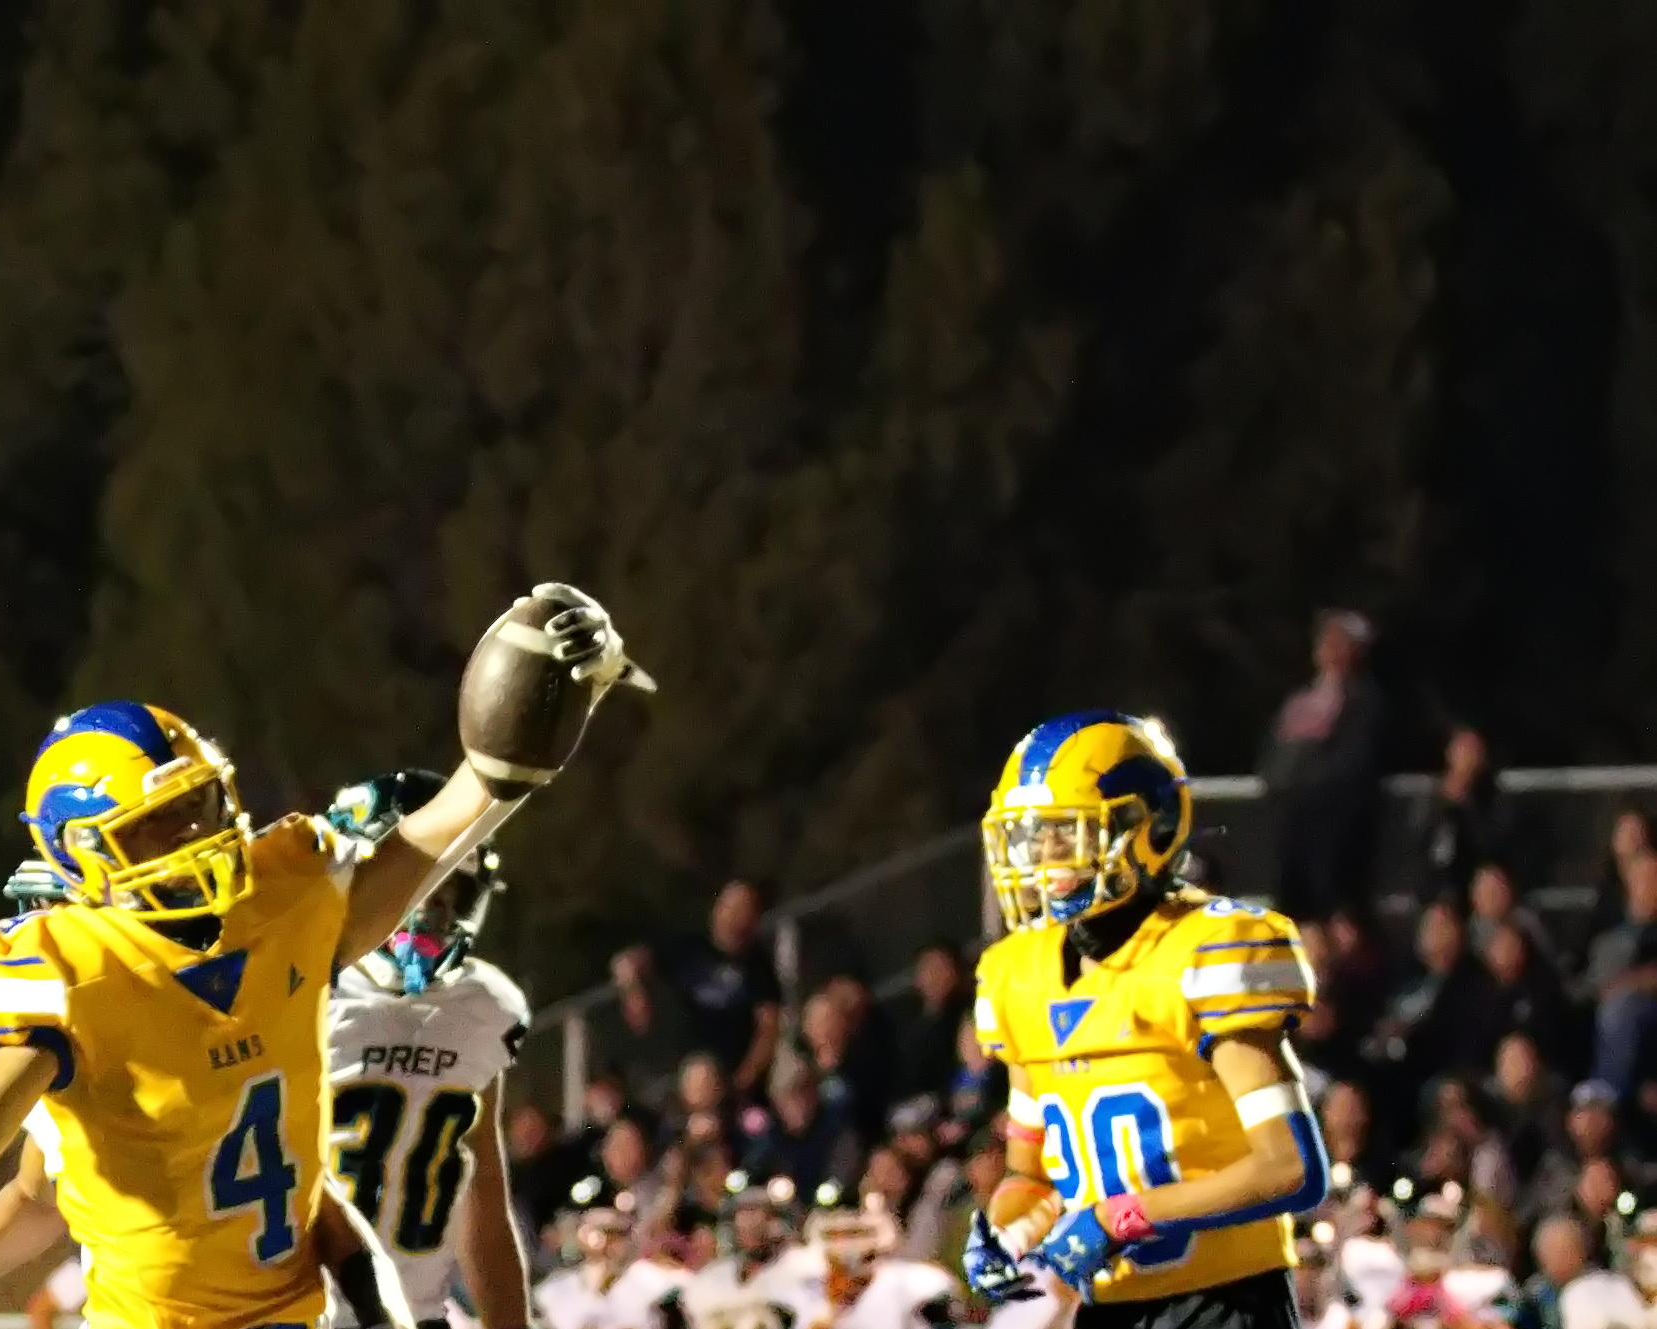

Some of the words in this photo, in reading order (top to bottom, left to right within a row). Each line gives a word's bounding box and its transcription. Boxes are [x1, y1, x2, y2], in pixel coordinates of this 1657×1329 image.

[361, 1045, 458, 1077] PREP
[206, 1068, 301, 1269] 4
[330, 1080, 481, 1256] 30
